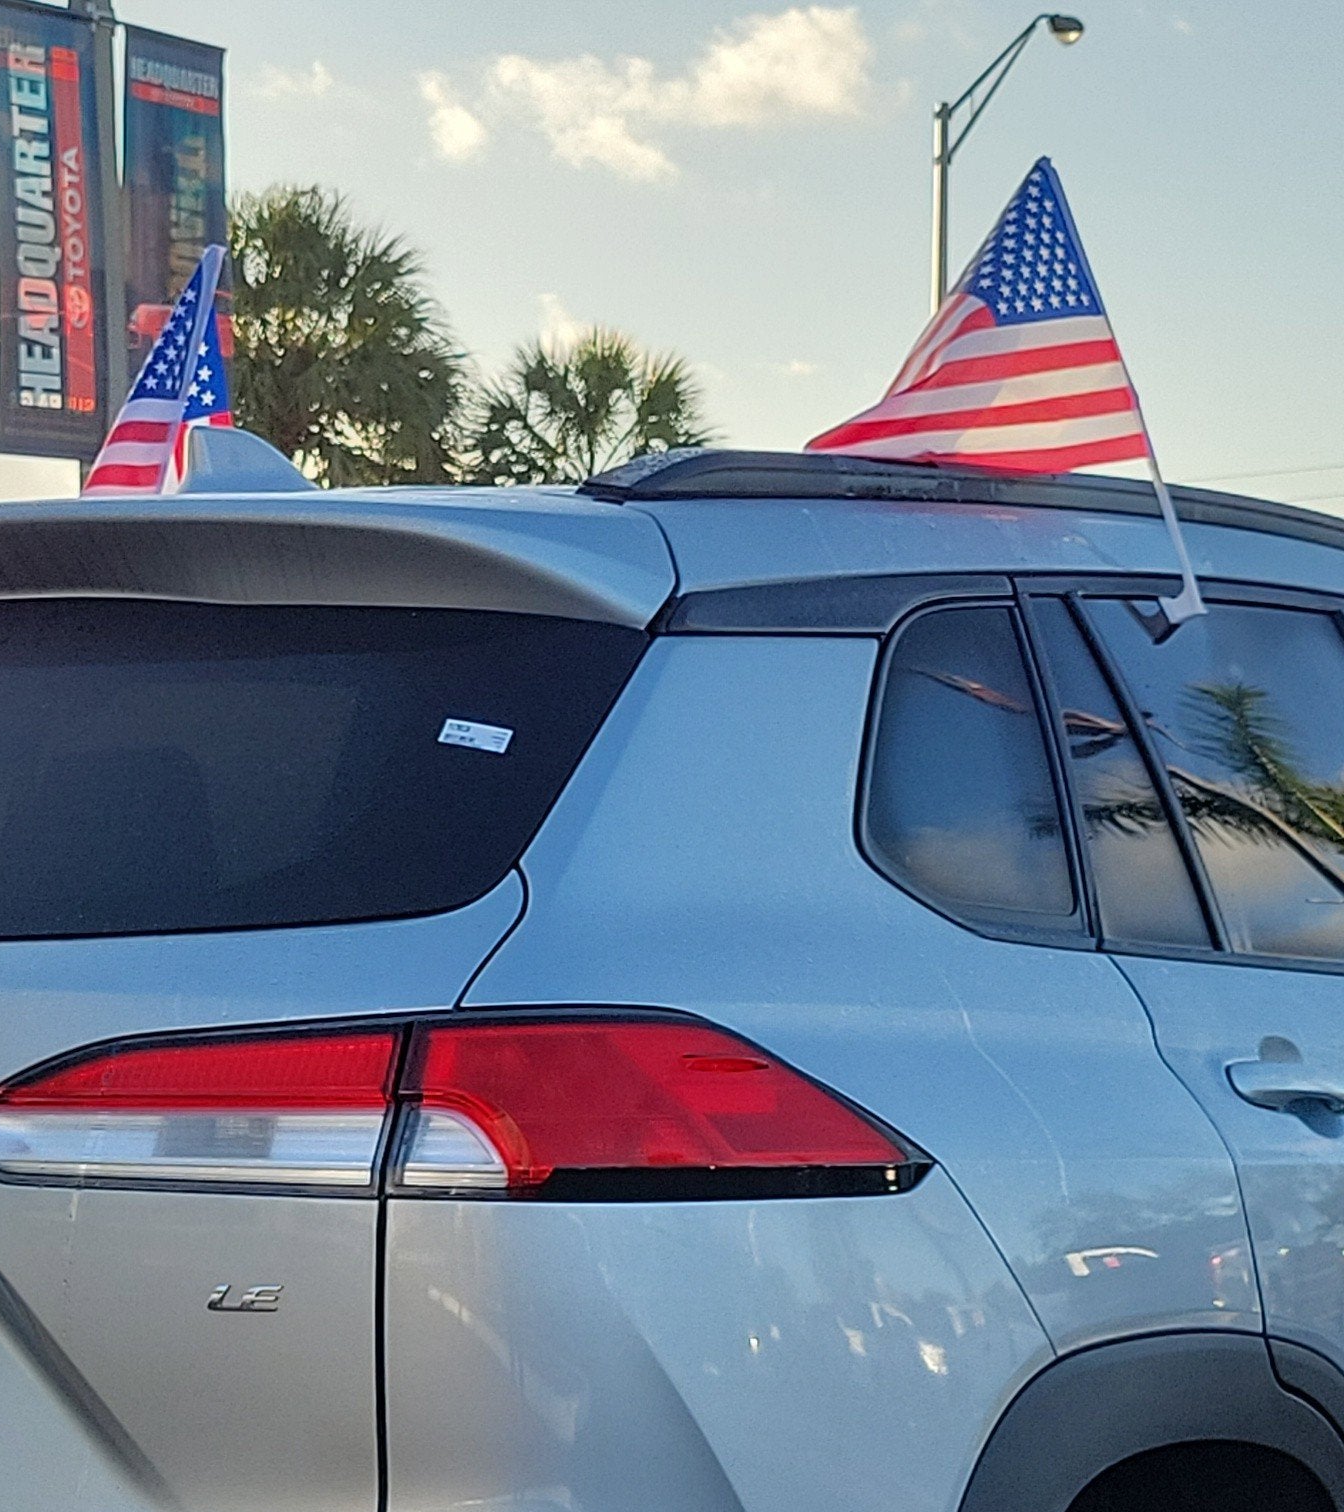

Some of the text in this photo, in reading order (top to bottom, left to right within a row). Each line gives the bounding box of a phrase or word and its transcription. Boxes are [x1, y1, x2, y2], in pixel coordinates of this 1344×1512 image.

[8, 43, 62, 410] HEADQUARTER
[59, 147, 88, 283] TOYOTA
[207, 1284, 284, 1312] LE
